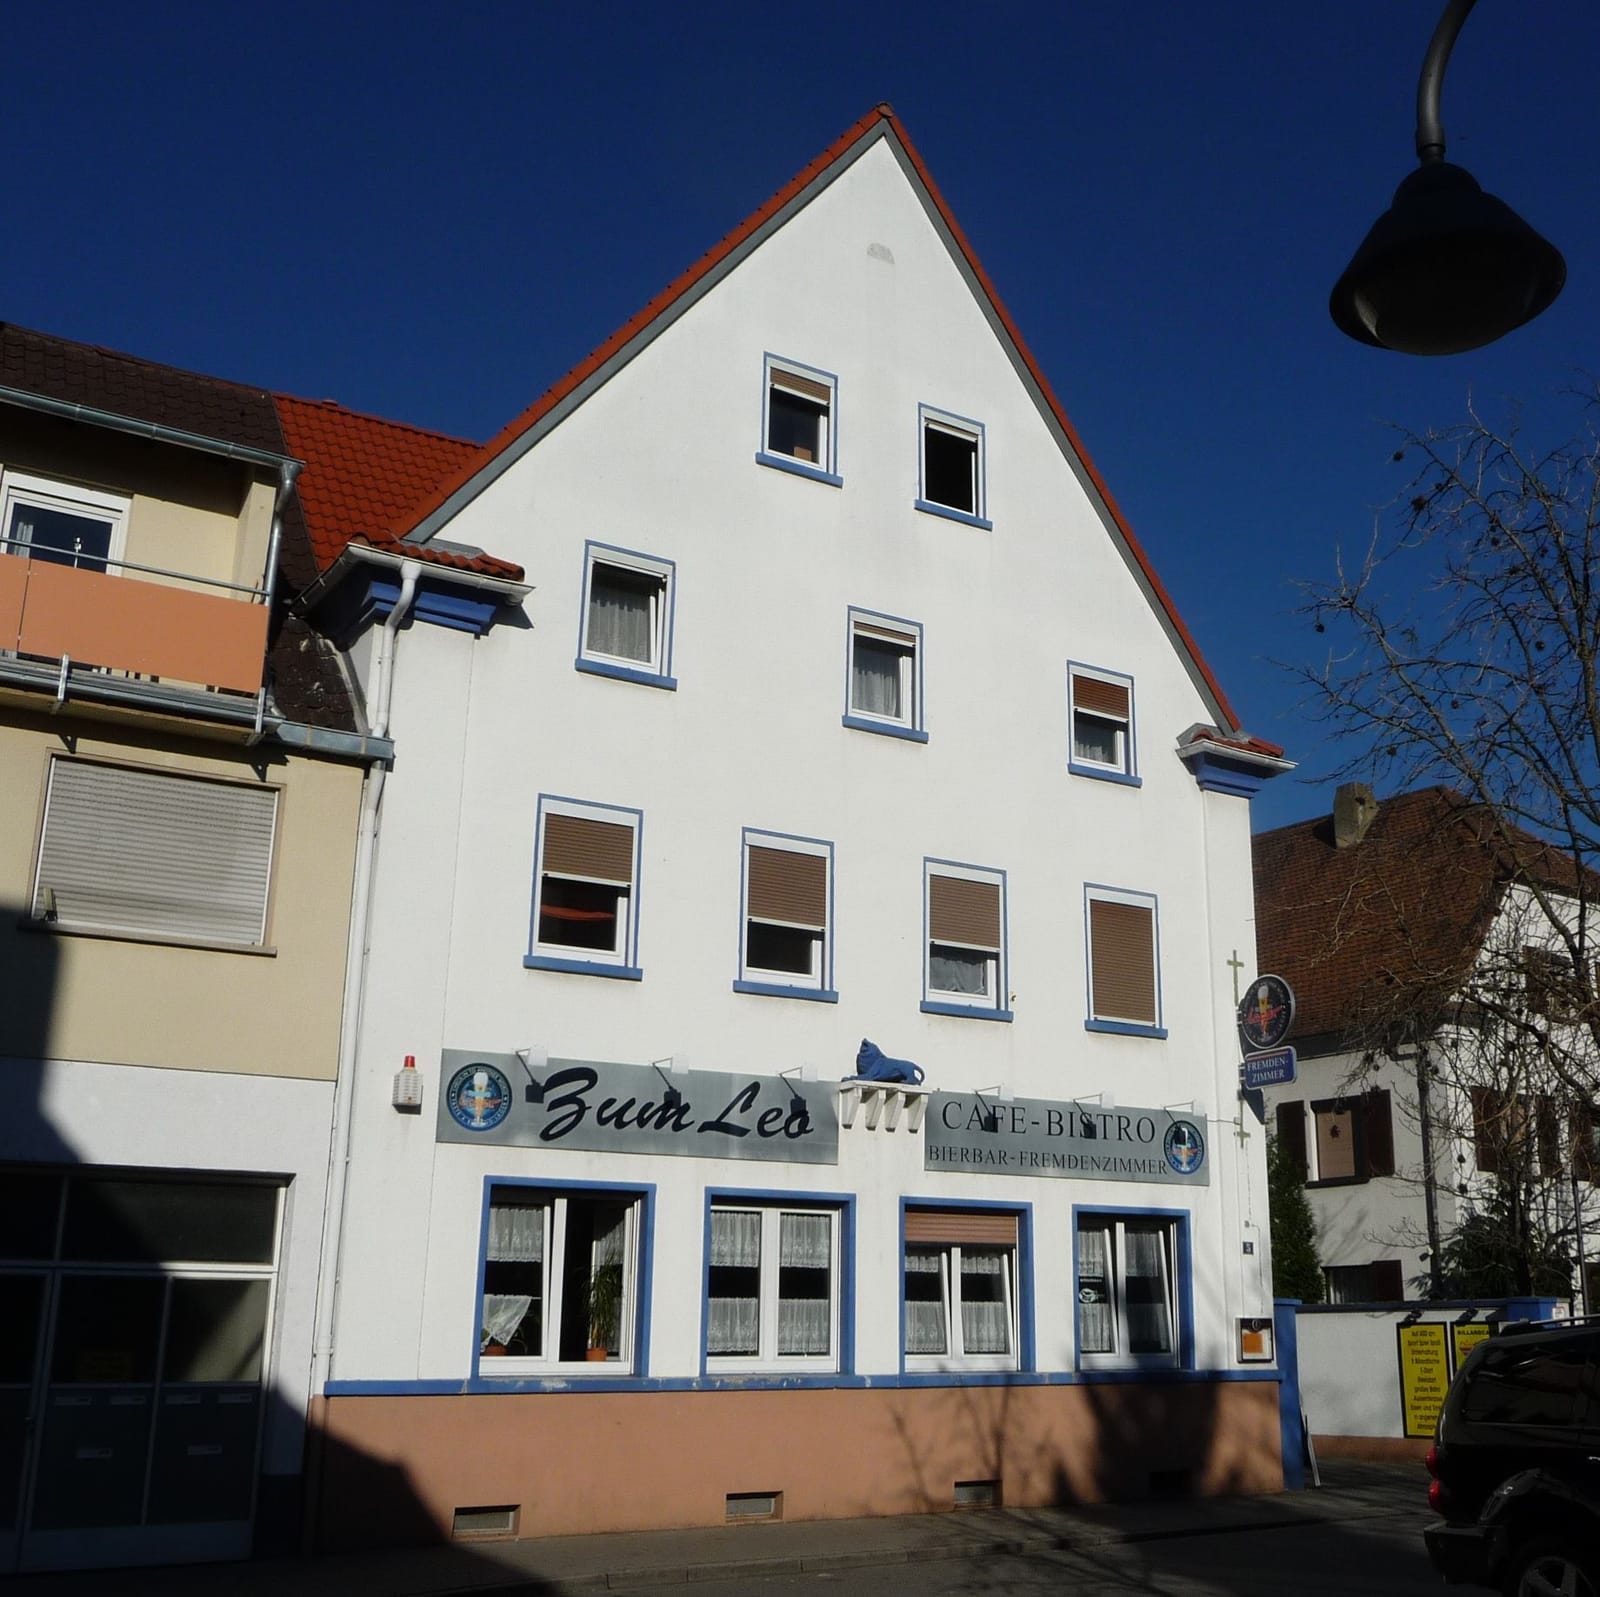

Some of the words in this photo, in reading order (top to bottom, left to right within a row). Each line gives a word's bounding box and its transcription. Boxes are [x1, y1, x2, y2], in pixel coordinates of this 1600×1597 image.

[1248, 1057, 1288, 1072] FREMDEN-
[1252, 1069, 1285, 1083] ZIMMER
[539, 1066, 695, 1141] Zum
[696, 1081, 814, 1139] Leo
[928, 1145, 1168, 1175] BIERBAR-FREMDENZIMMER
